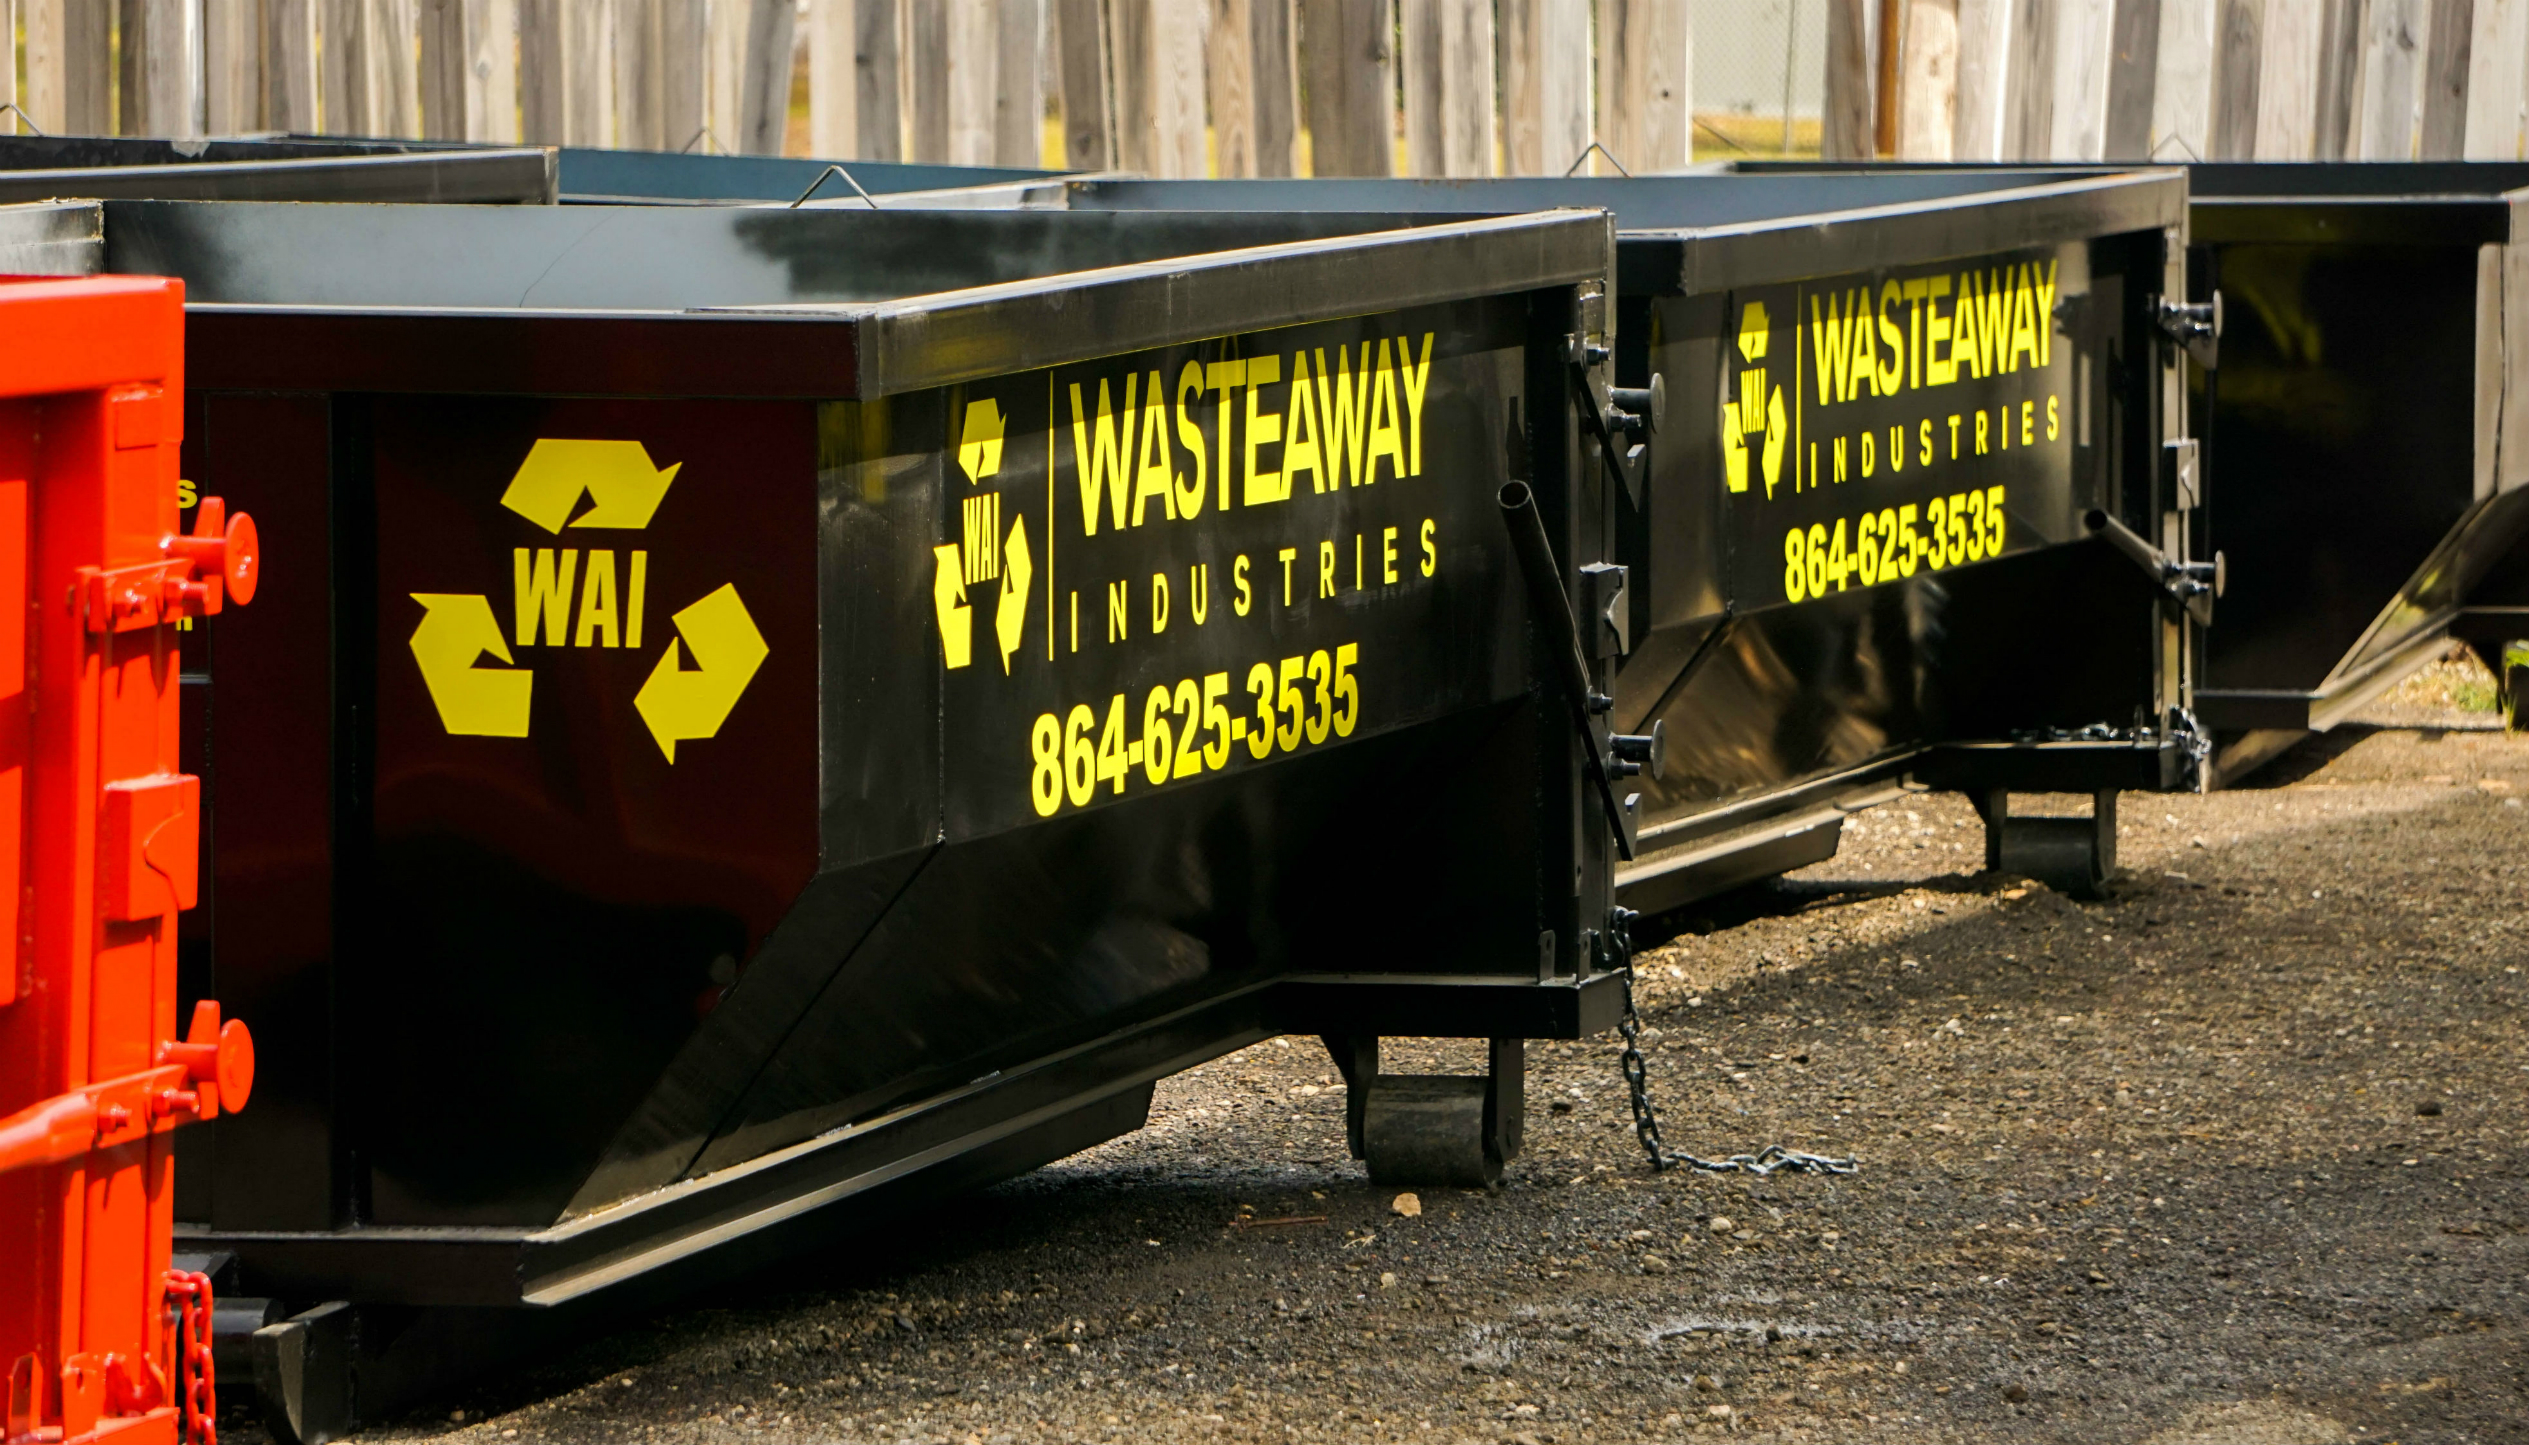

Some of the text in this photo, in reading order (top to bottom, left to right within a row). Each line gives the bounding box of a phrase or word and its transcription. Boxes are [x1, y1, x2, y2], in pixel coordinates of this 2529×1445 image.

[1812, 259, 2058, 406] WASTEAWAY
[1070, 333, 1433, 537] WASTEAWAY
[1741, 368, 1766, 434] WAI
[1811, 393, 2060, 488] INDUSTRIES
[963, 492, 999, 585] WAI
[1071, 519, 1436, 652] INDUSTRIES
[1785, 485, 2005, 603] 864-625-3535
[514, 548, 647, 648] WAI
[1032, 643, 1358, 817] 864-625-3535
